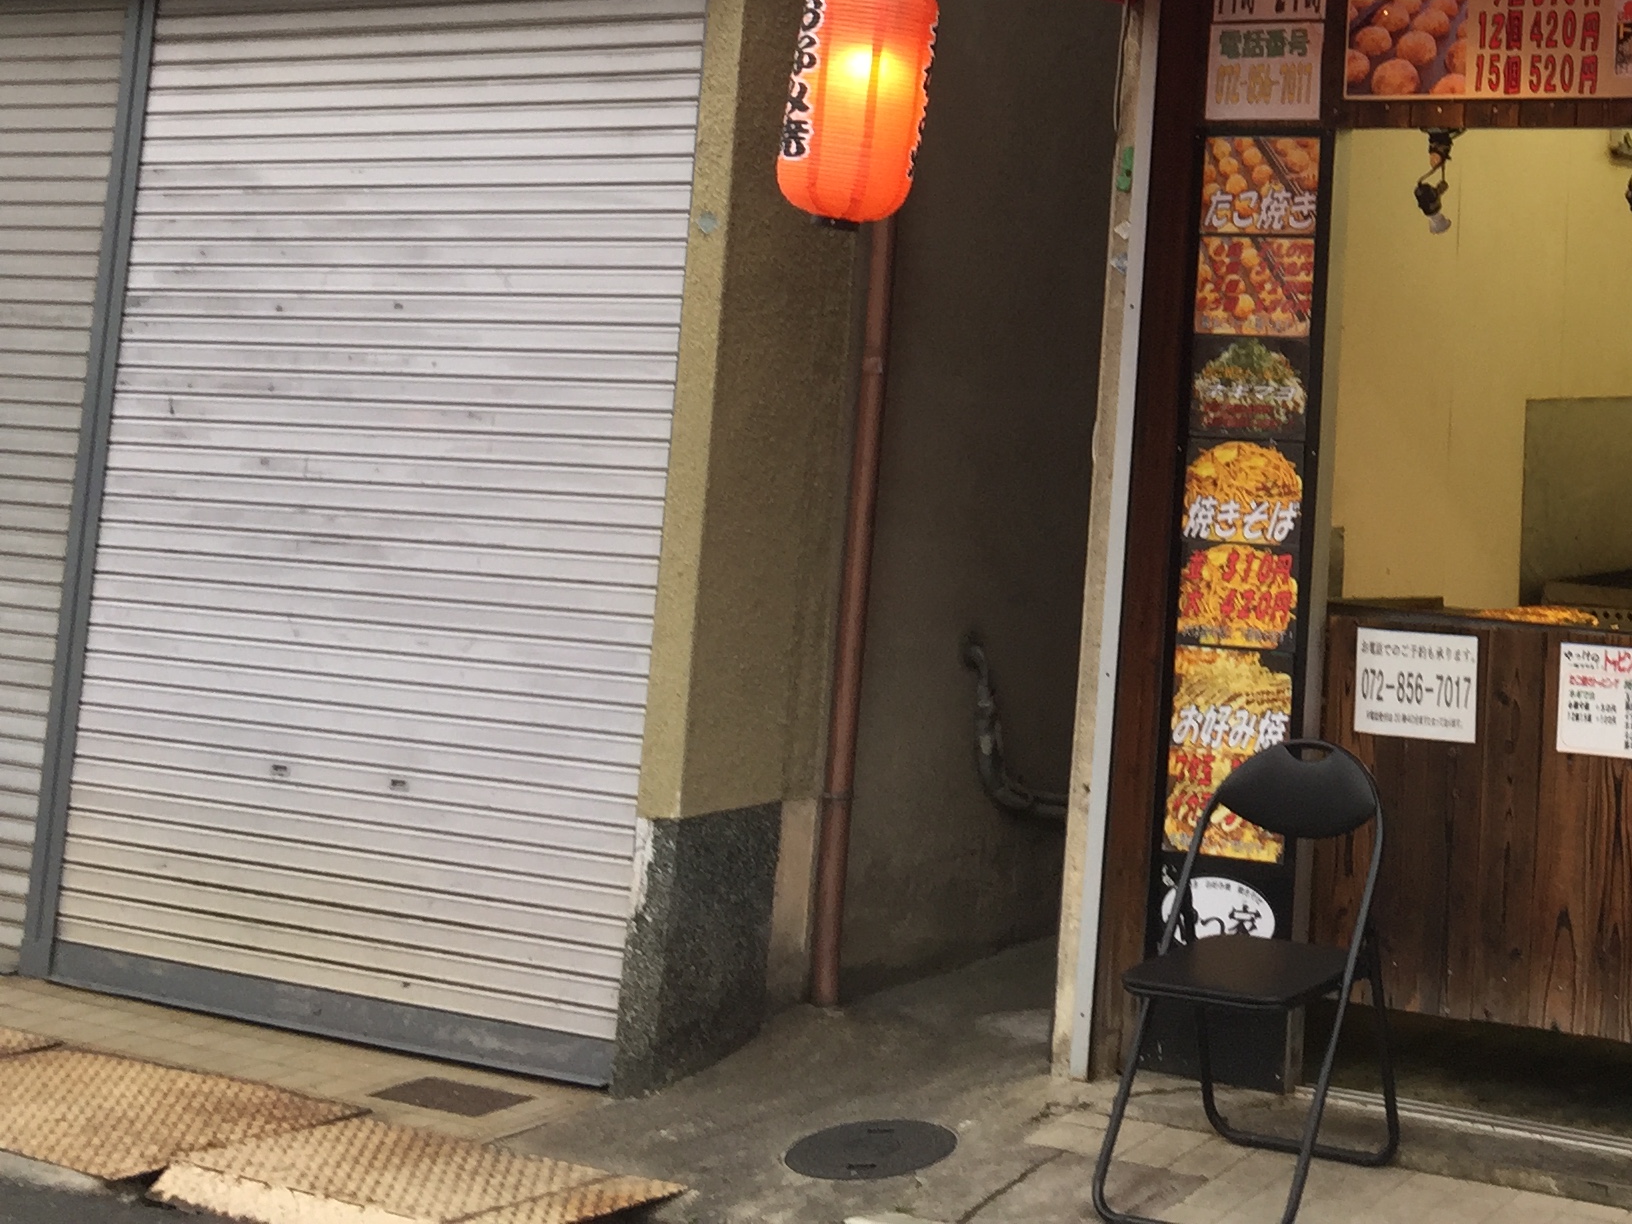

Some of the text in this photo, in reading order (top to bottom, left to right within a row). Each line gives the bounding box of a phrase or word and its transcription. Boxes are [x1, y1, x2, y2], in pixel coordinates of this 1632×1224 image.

[1219, 29, 1311, 59] 電話番号
[1204, 188, 1317, 229] たこ焼き
[1184, 495, 1301, 542] 焼きそば
[1361, 667, 1472, 710] 072-856-7017
[1172, 704, 1290, 754] お好み焼
